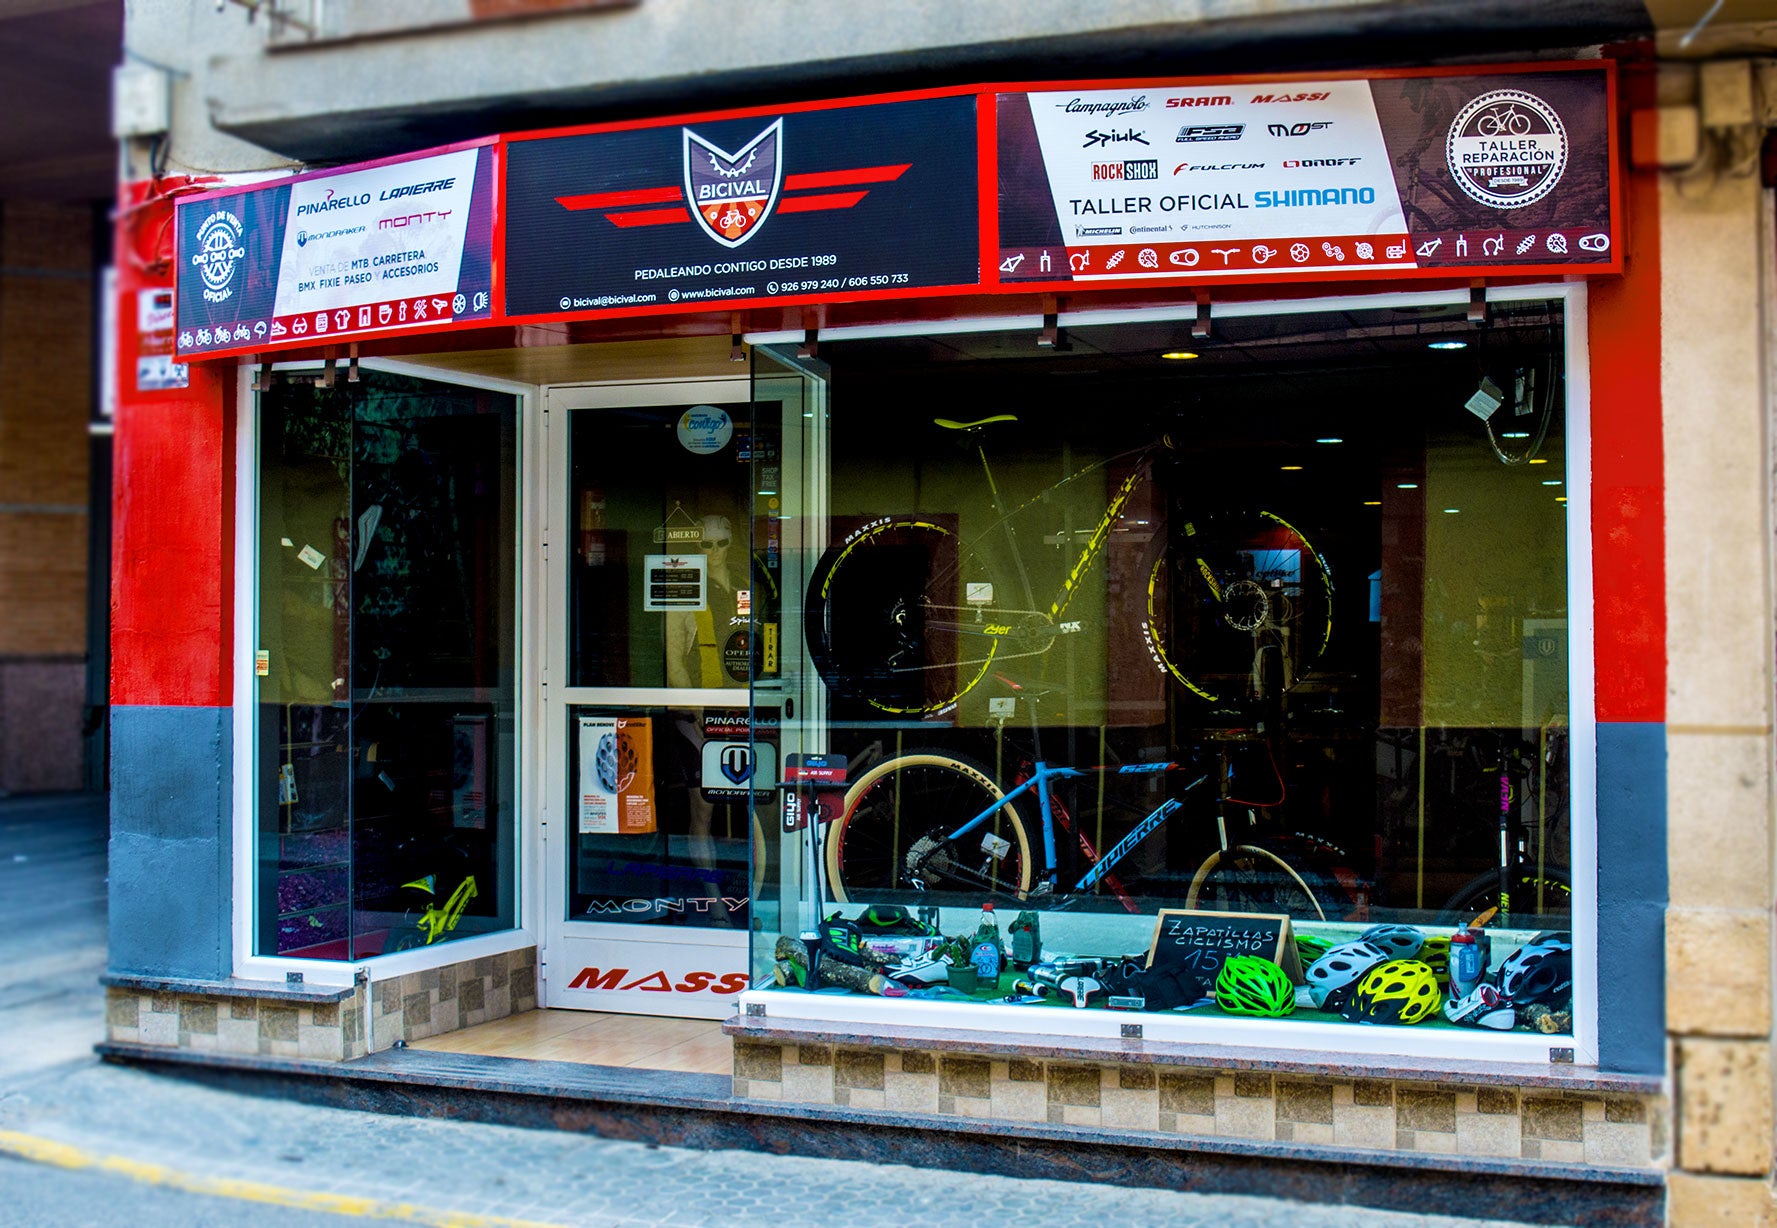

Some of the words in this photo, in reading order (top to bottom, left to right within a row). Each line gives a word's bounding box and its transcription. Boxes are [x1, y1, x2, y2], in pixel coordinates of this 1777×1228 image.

[1057, 95, 1150, 117] Campagnolo
[1165, 95, 1231, 108] SRAM
[1250, 91, 1331, 104] MASSI
[1083, 128, 1150, 148] Spiuk
[1267, 122, 1333, 137] MOST
[1479, 140, 1537, 151] TALLER
[1302, 157, 1362, 168] ONOFF
[1463, 148, 1554, 163] REPARACIÓN
[1189, 163, 1265, 171] FULCRUM
[1473, 165, 1542, 176] PROFESIONAL
[379, 177, 456, 201] LAPIERRE
[699, 180, 766, 200] BICIVAL
[297, 193, 371, 216] PINARELLO
[1069, 198, 1151, 216] TALLER
[1159, 193, 1249, 213] OFICIAL
[1254, 187, 1375, 208] SHIMANO
[196, 213, 216, 241] PUNTO
[216, 210, 226, 220] DE
[226, 212, 243, 237] VENTA
[379, 209, 452, 230] MONTY
[308, 225, 366, 241] MONDRAKER
[1085, 227, 1121, 235] MICHELIN
[1130, 226, 1168, 234] Continental
[308, 263, 336, 276] VENTA
[338, 261, 349, 272] DE
[351, 258, 369, 270] MTB
[373, 249, 426, 267] CARRETERA
[634, 264, 712, 280] PEDALEANDO
[714, 259, 767, 274] CONTIGO
[769, 256, 809, 270] DESDE
[810, 254, 837, 267] 1989
[298, 281, 316, 292] BMX
[320, 277, 341, 289] FIXIE
[344, 272, 372, 285] PASEO
[374, 271, 381, 280] Y
[382, 262, 439, 280] ACCESORIOS
[781, 281, 799, 292] 926
[801, 280, 819, 290] 979
[820, 279, 839, 290] 240
[841, 277, 848, 288] /
[849, 276, 867, 287] 606
[870, 275, 889, 286] 550
[891, 273, 909, 284] 733
[203, 287, 232, 303] OFICIAL
[573, 293, 656, 307] bicival@bicival.com
[681, 286, 755, 299] www.bicival.com
[667, 530, 700, 539] ABIERTO
[845, 517, 891, 545] MAXXIS
[1141, 621, 1168, 673] MAXXIS
[951, 763, 997, 794] MAXXIS
[1082, 799, 1179, 890] LAPIERRE
[586, 897, 750, 914] MONTY
[1168, 920, 1274, 942] ZAPATILLAS
[1175, 936, 1262, 951] CICLISMO
[1184, 948, 1219, 971] 15
